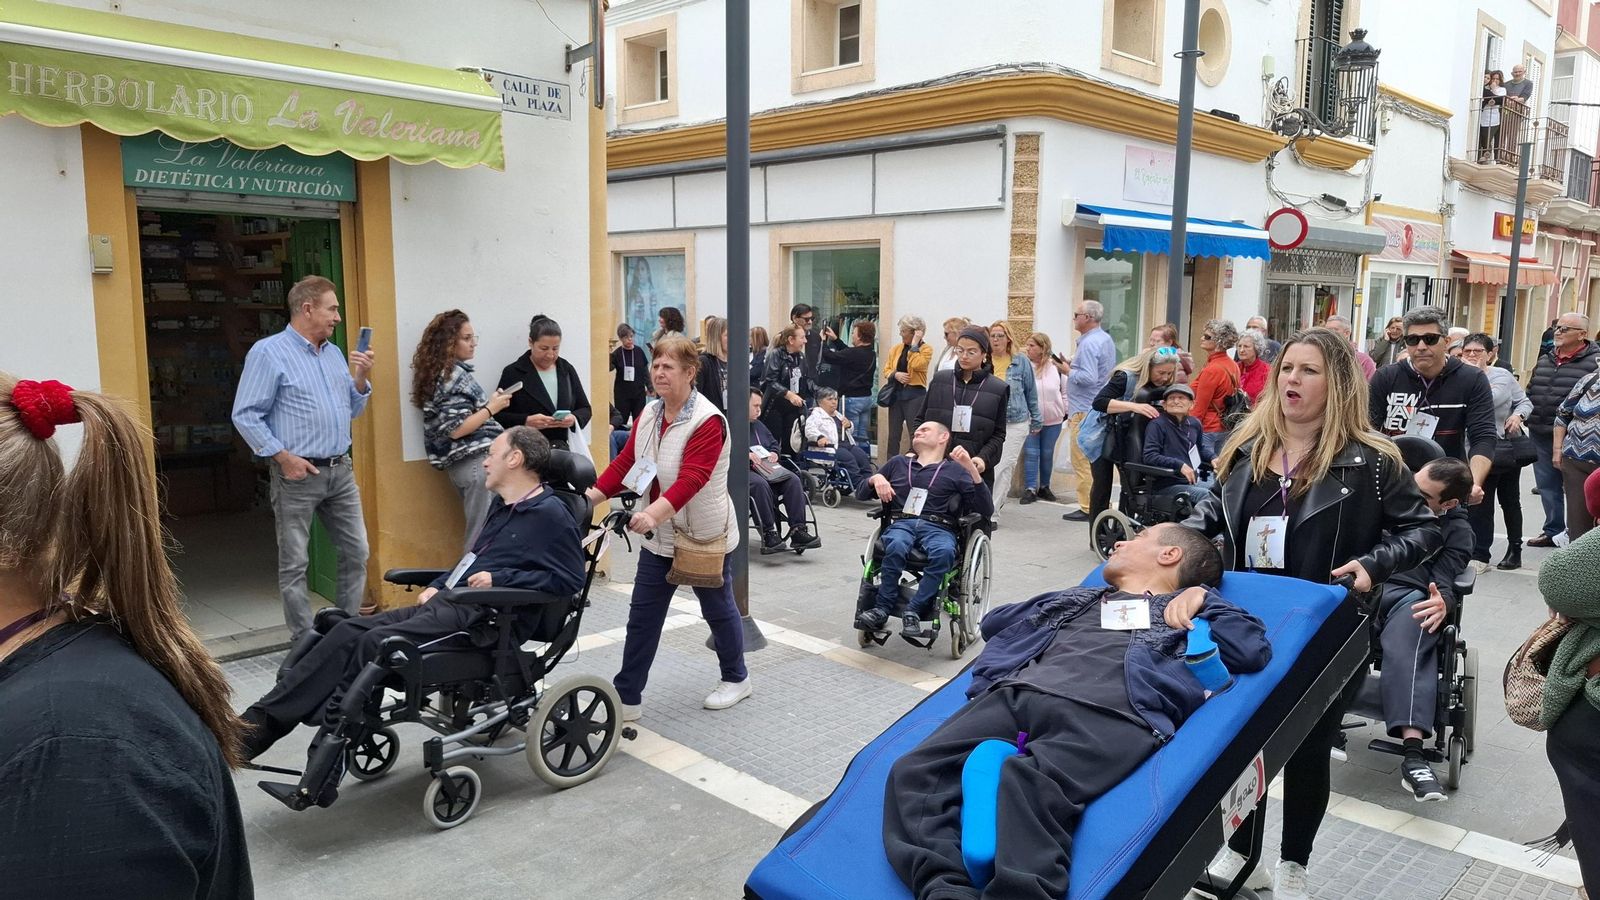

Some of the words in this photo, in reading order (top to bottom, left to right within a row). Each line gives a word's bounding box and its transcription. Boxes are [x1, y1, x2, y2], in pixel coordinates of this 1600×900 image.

[501, 93, 517, 107] LA
[528, 97, 563, 114] PLAZA
[503, 79, 540, 96] CALLE
[547, 86, 562, 100] DE
[8, 60, 254, 125] HERBOLARIO
[267, 89, 321, 132] La
[335, 98, 482, 150] Valeriana
[153, 133, 207, 168] La
[208, 140, 326, 178] Valeriana
[134, 168, 235, 190] DIETÉTICA
[238, 176, 250, 191] Y
[251, 178, 344, 198] NUTRICIÓN
